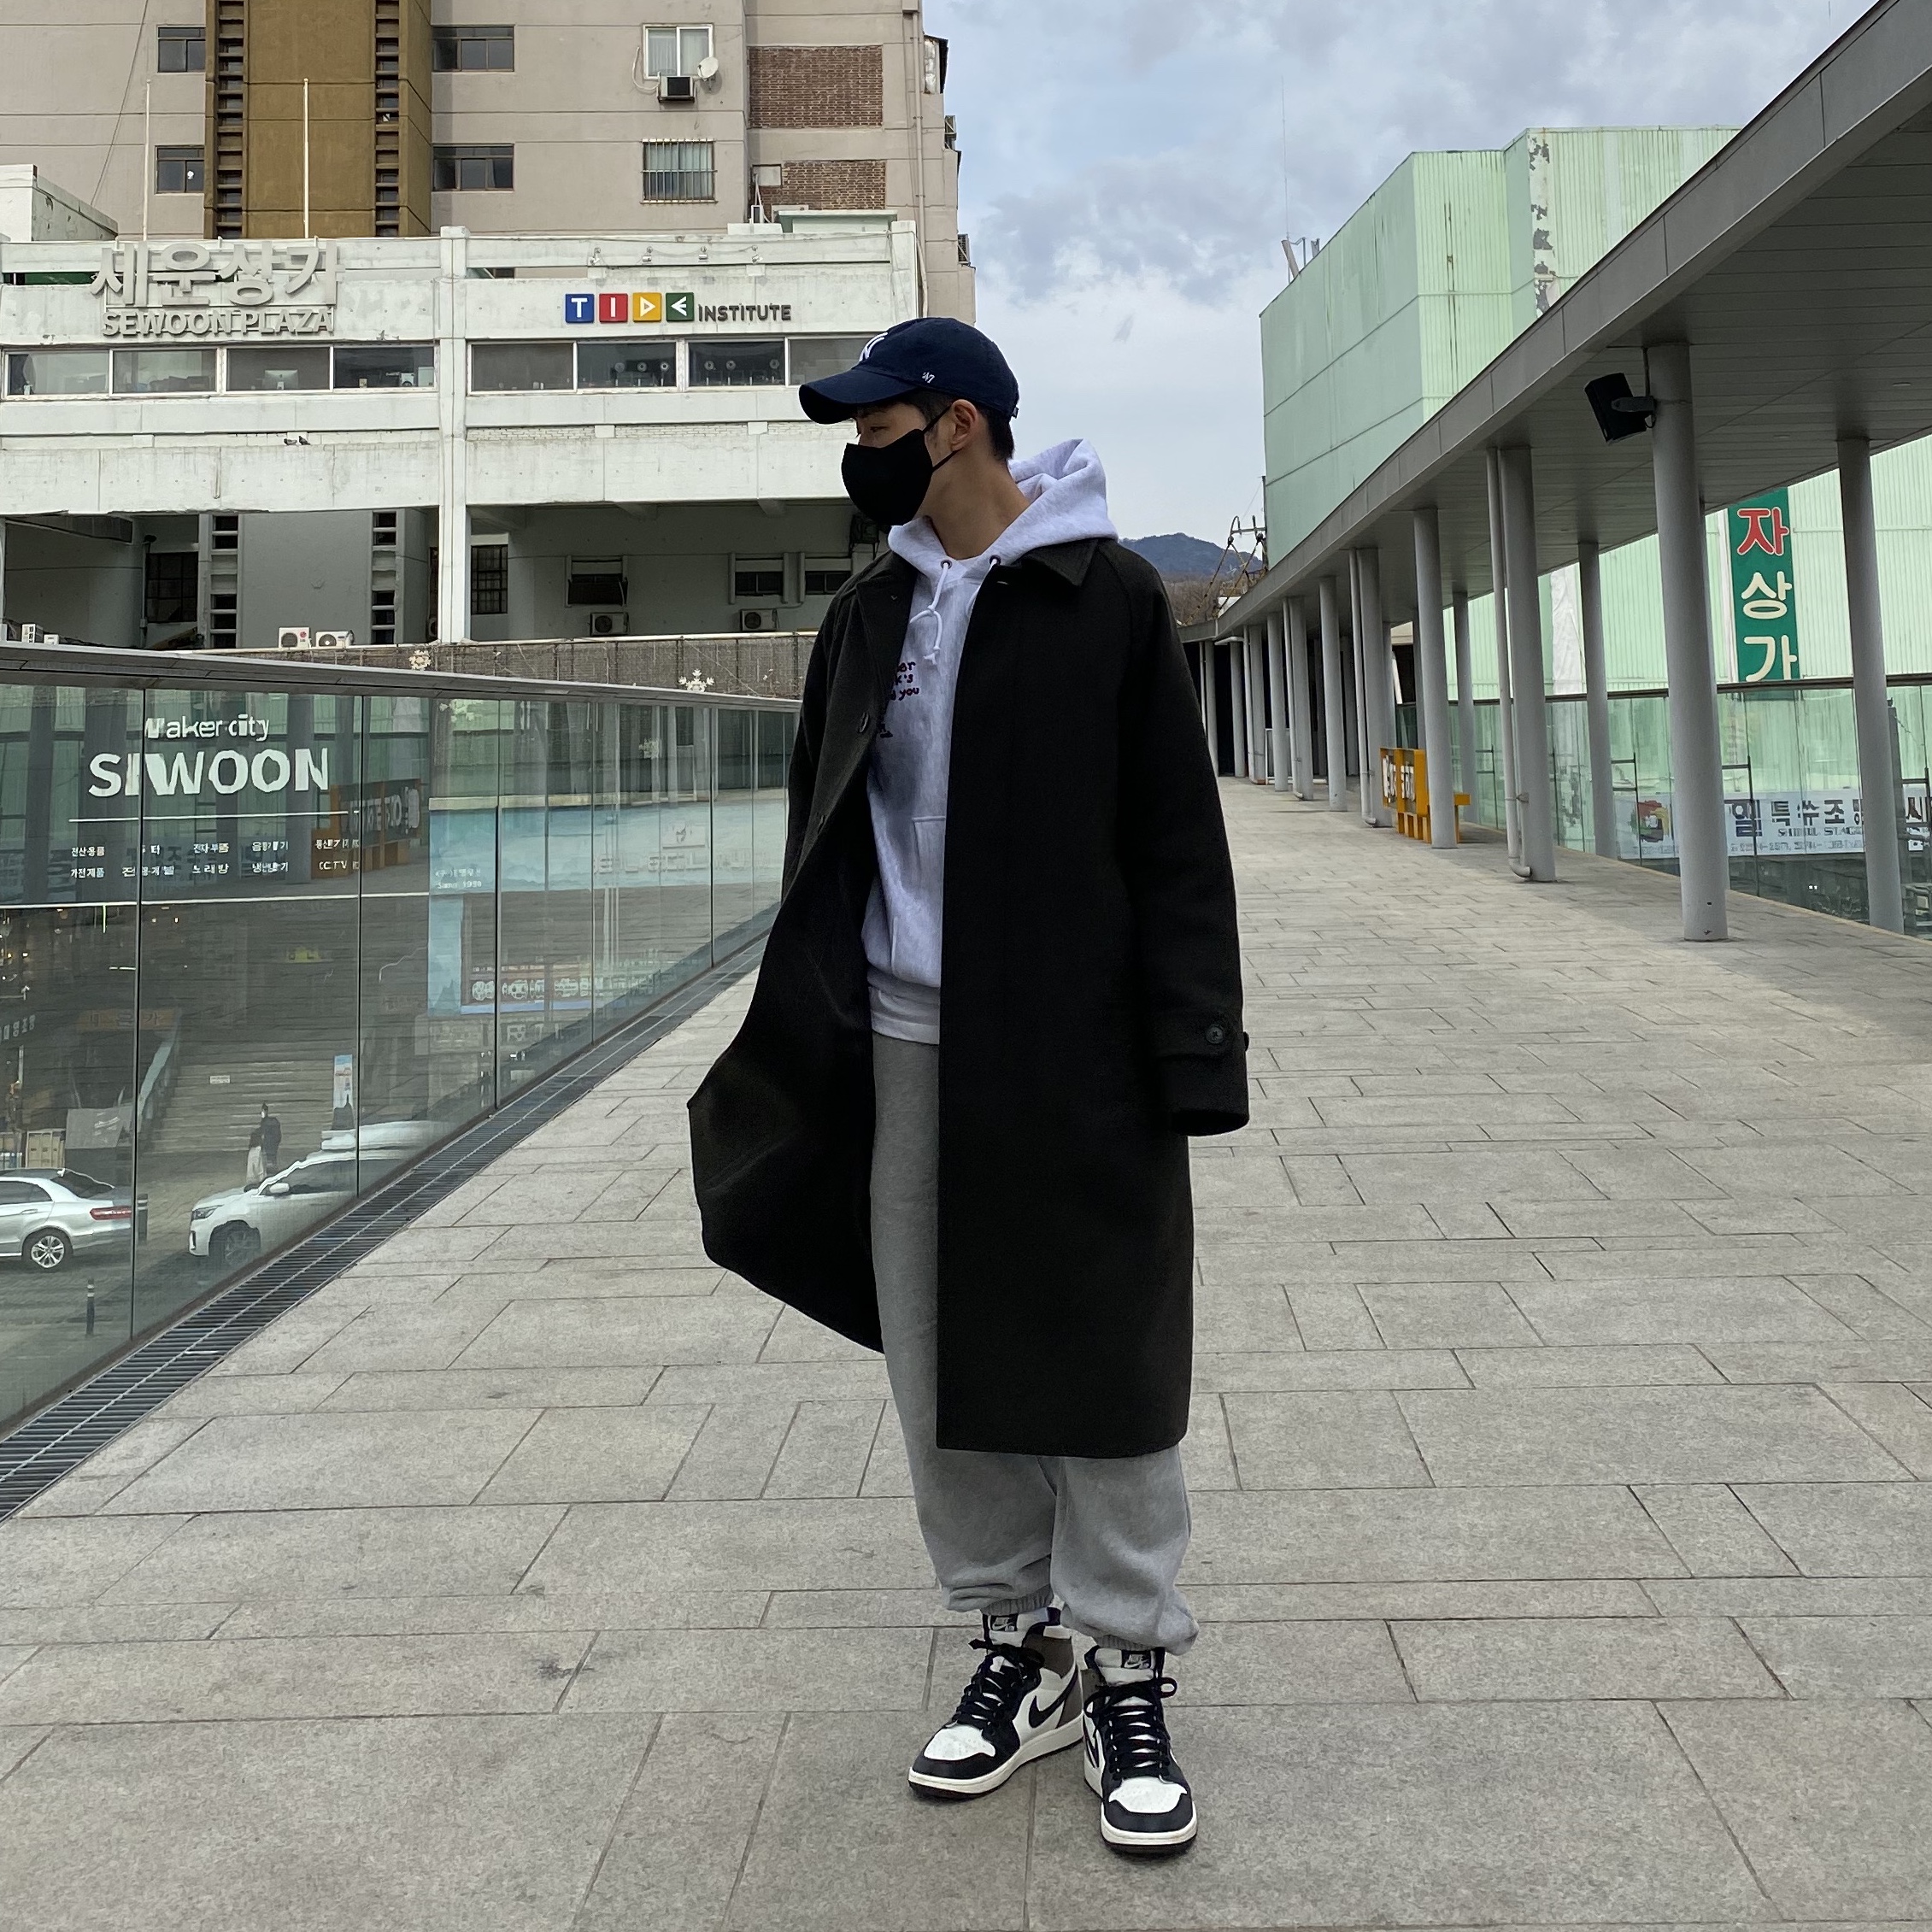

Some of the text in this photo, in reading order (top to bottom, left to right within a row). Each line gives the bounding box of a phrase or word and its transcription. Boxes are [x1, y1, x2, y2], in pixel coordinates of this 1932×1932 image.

[90, 241, 345, 306] 세운상가
[102, 308, 333, 336] SEWOON PLAZA
[567, 295, 791, 321] TIDE INSTITUTE
